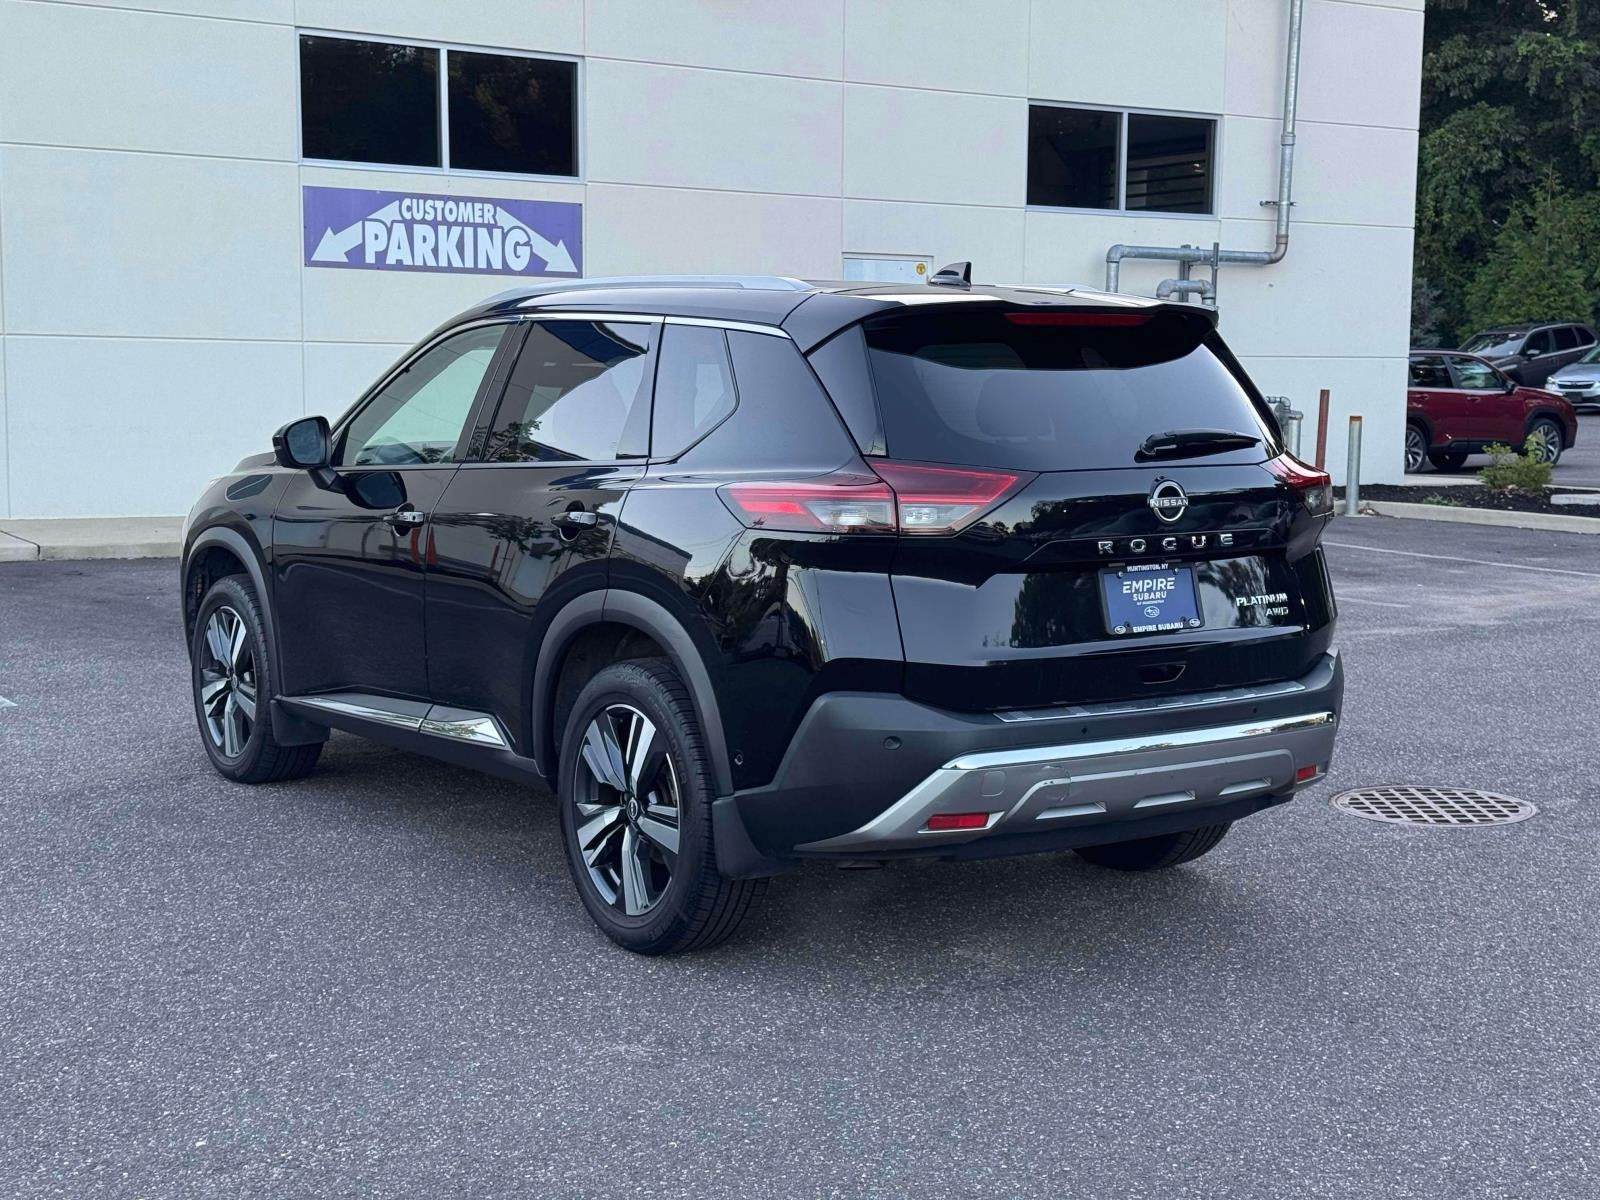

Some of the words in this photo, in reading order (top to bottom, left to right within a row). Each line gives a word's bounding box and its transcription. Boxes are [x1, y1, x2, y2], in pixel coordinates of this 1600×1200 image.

[401, 198, 497, 225] CUSTOMER
[364, 220, 532, 272] PARKING
[1151, 498, 1189, 507] NISSAN
[1098, 533, 1234, 554] ROGUE
[1161, 562, 1169, 570] NY
[1122, 577, 1176, 594] EMPIRE
[1132, 590, 1167, 602] SUBARU
[1235, 592, 1289, 607] PLATINUM
[1265, 606, 1289, 617] AWD
[1132, 624, 1158, 633] EMPIRE
[1158, 621, 1184, 631] SUBARU
